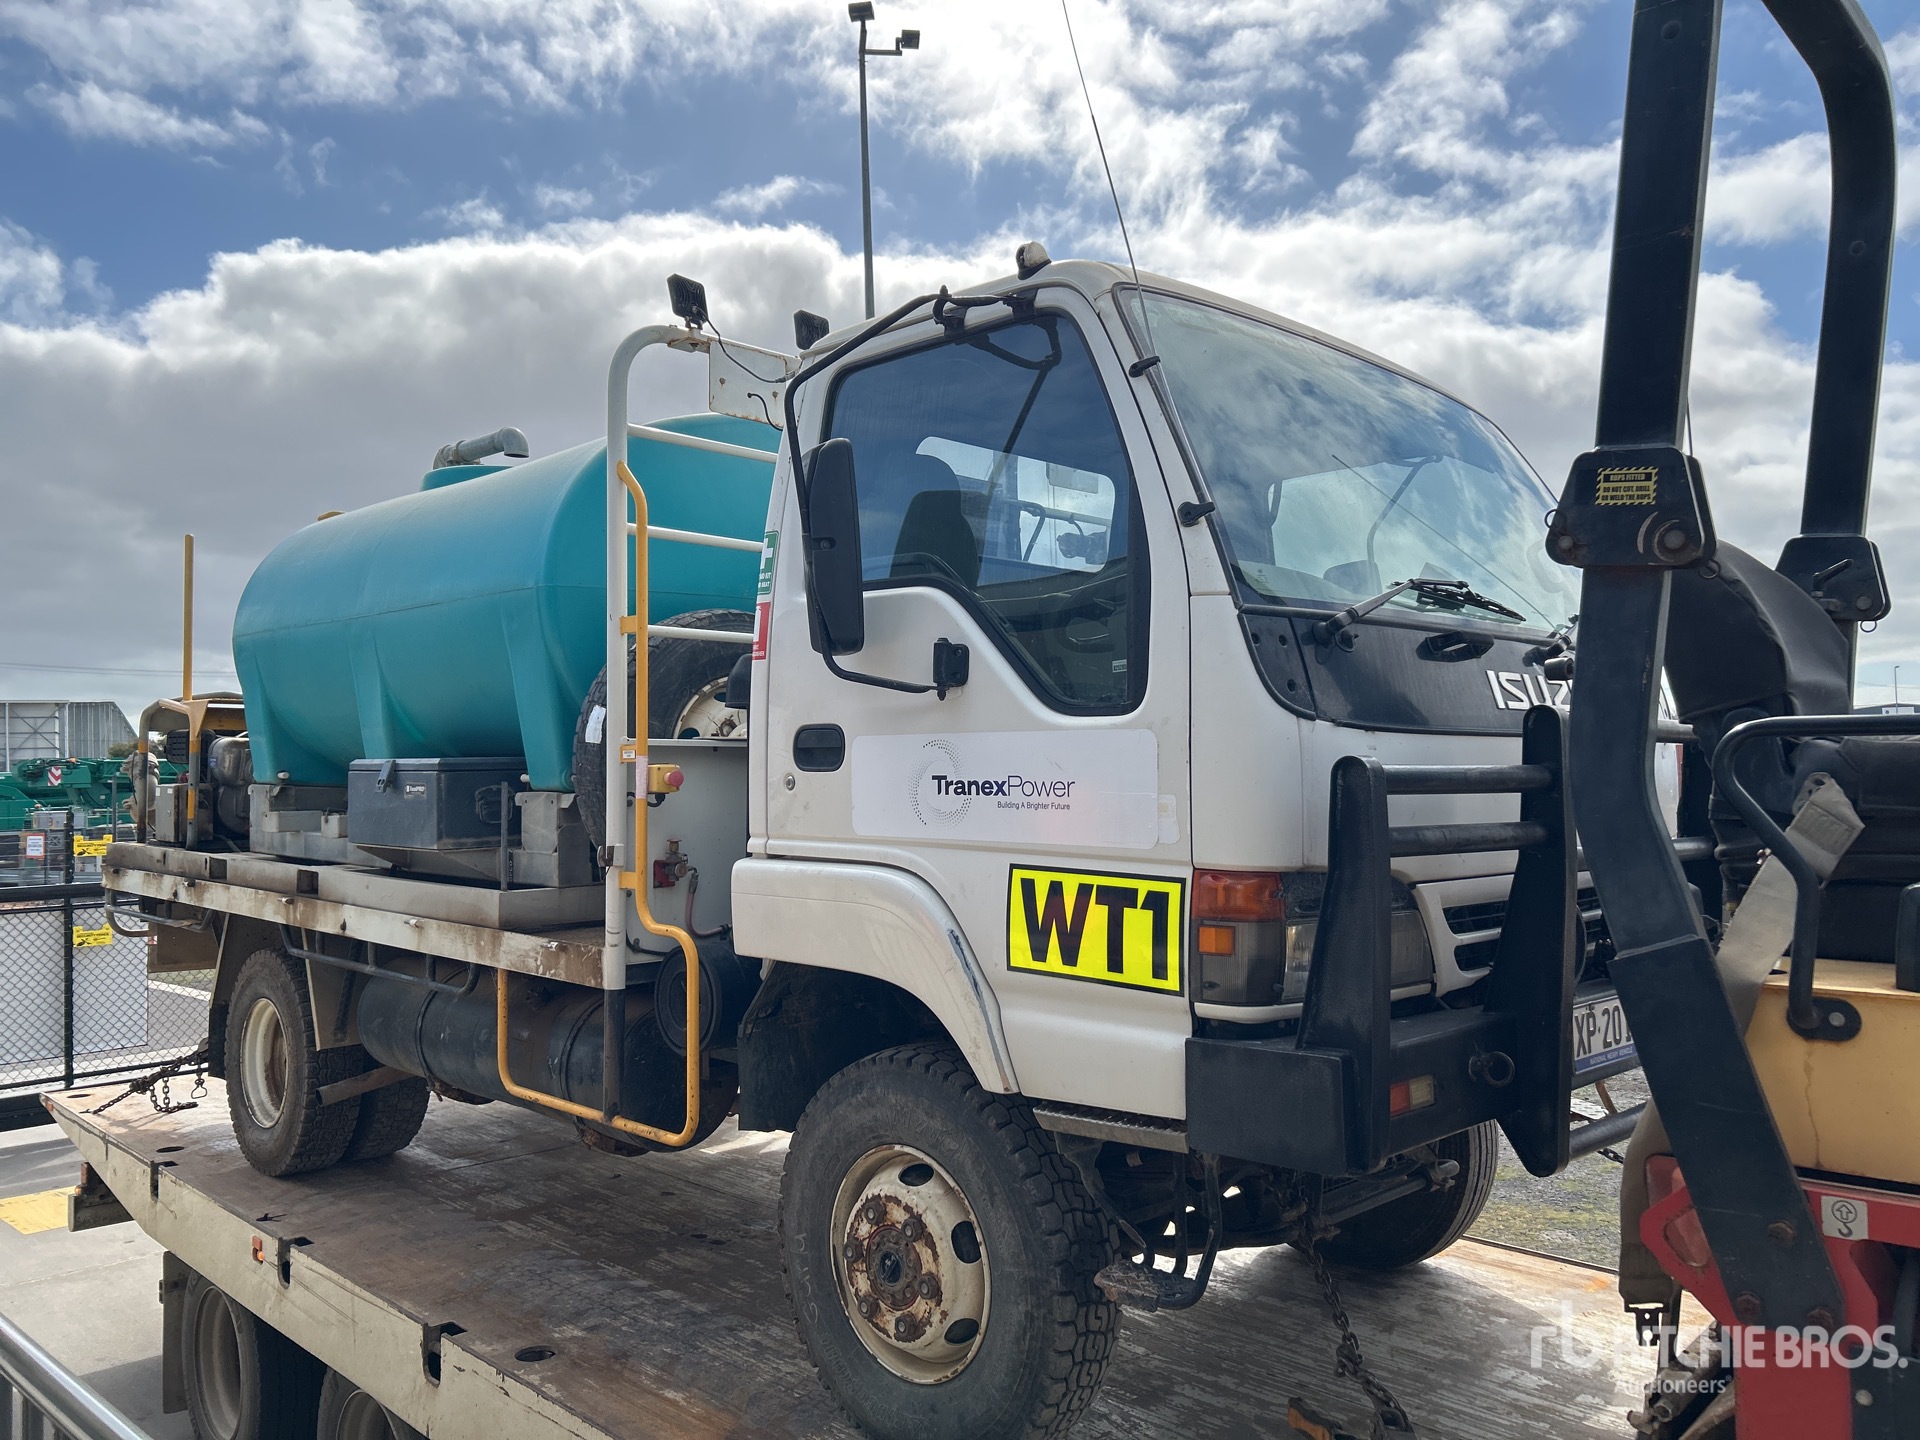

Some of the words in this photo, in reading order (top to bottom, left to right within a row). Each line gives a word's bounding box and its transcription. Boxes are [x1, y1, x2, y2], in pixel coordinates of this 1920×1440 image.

[932, 775, 1075, 797] TranexPower
[998, 801, 1020, 810] Building
[1026, 802, 1050, 811] Brighter
[1051, 802, 1070, 811] Future
[1020, 877, 1169, 981] WT1
